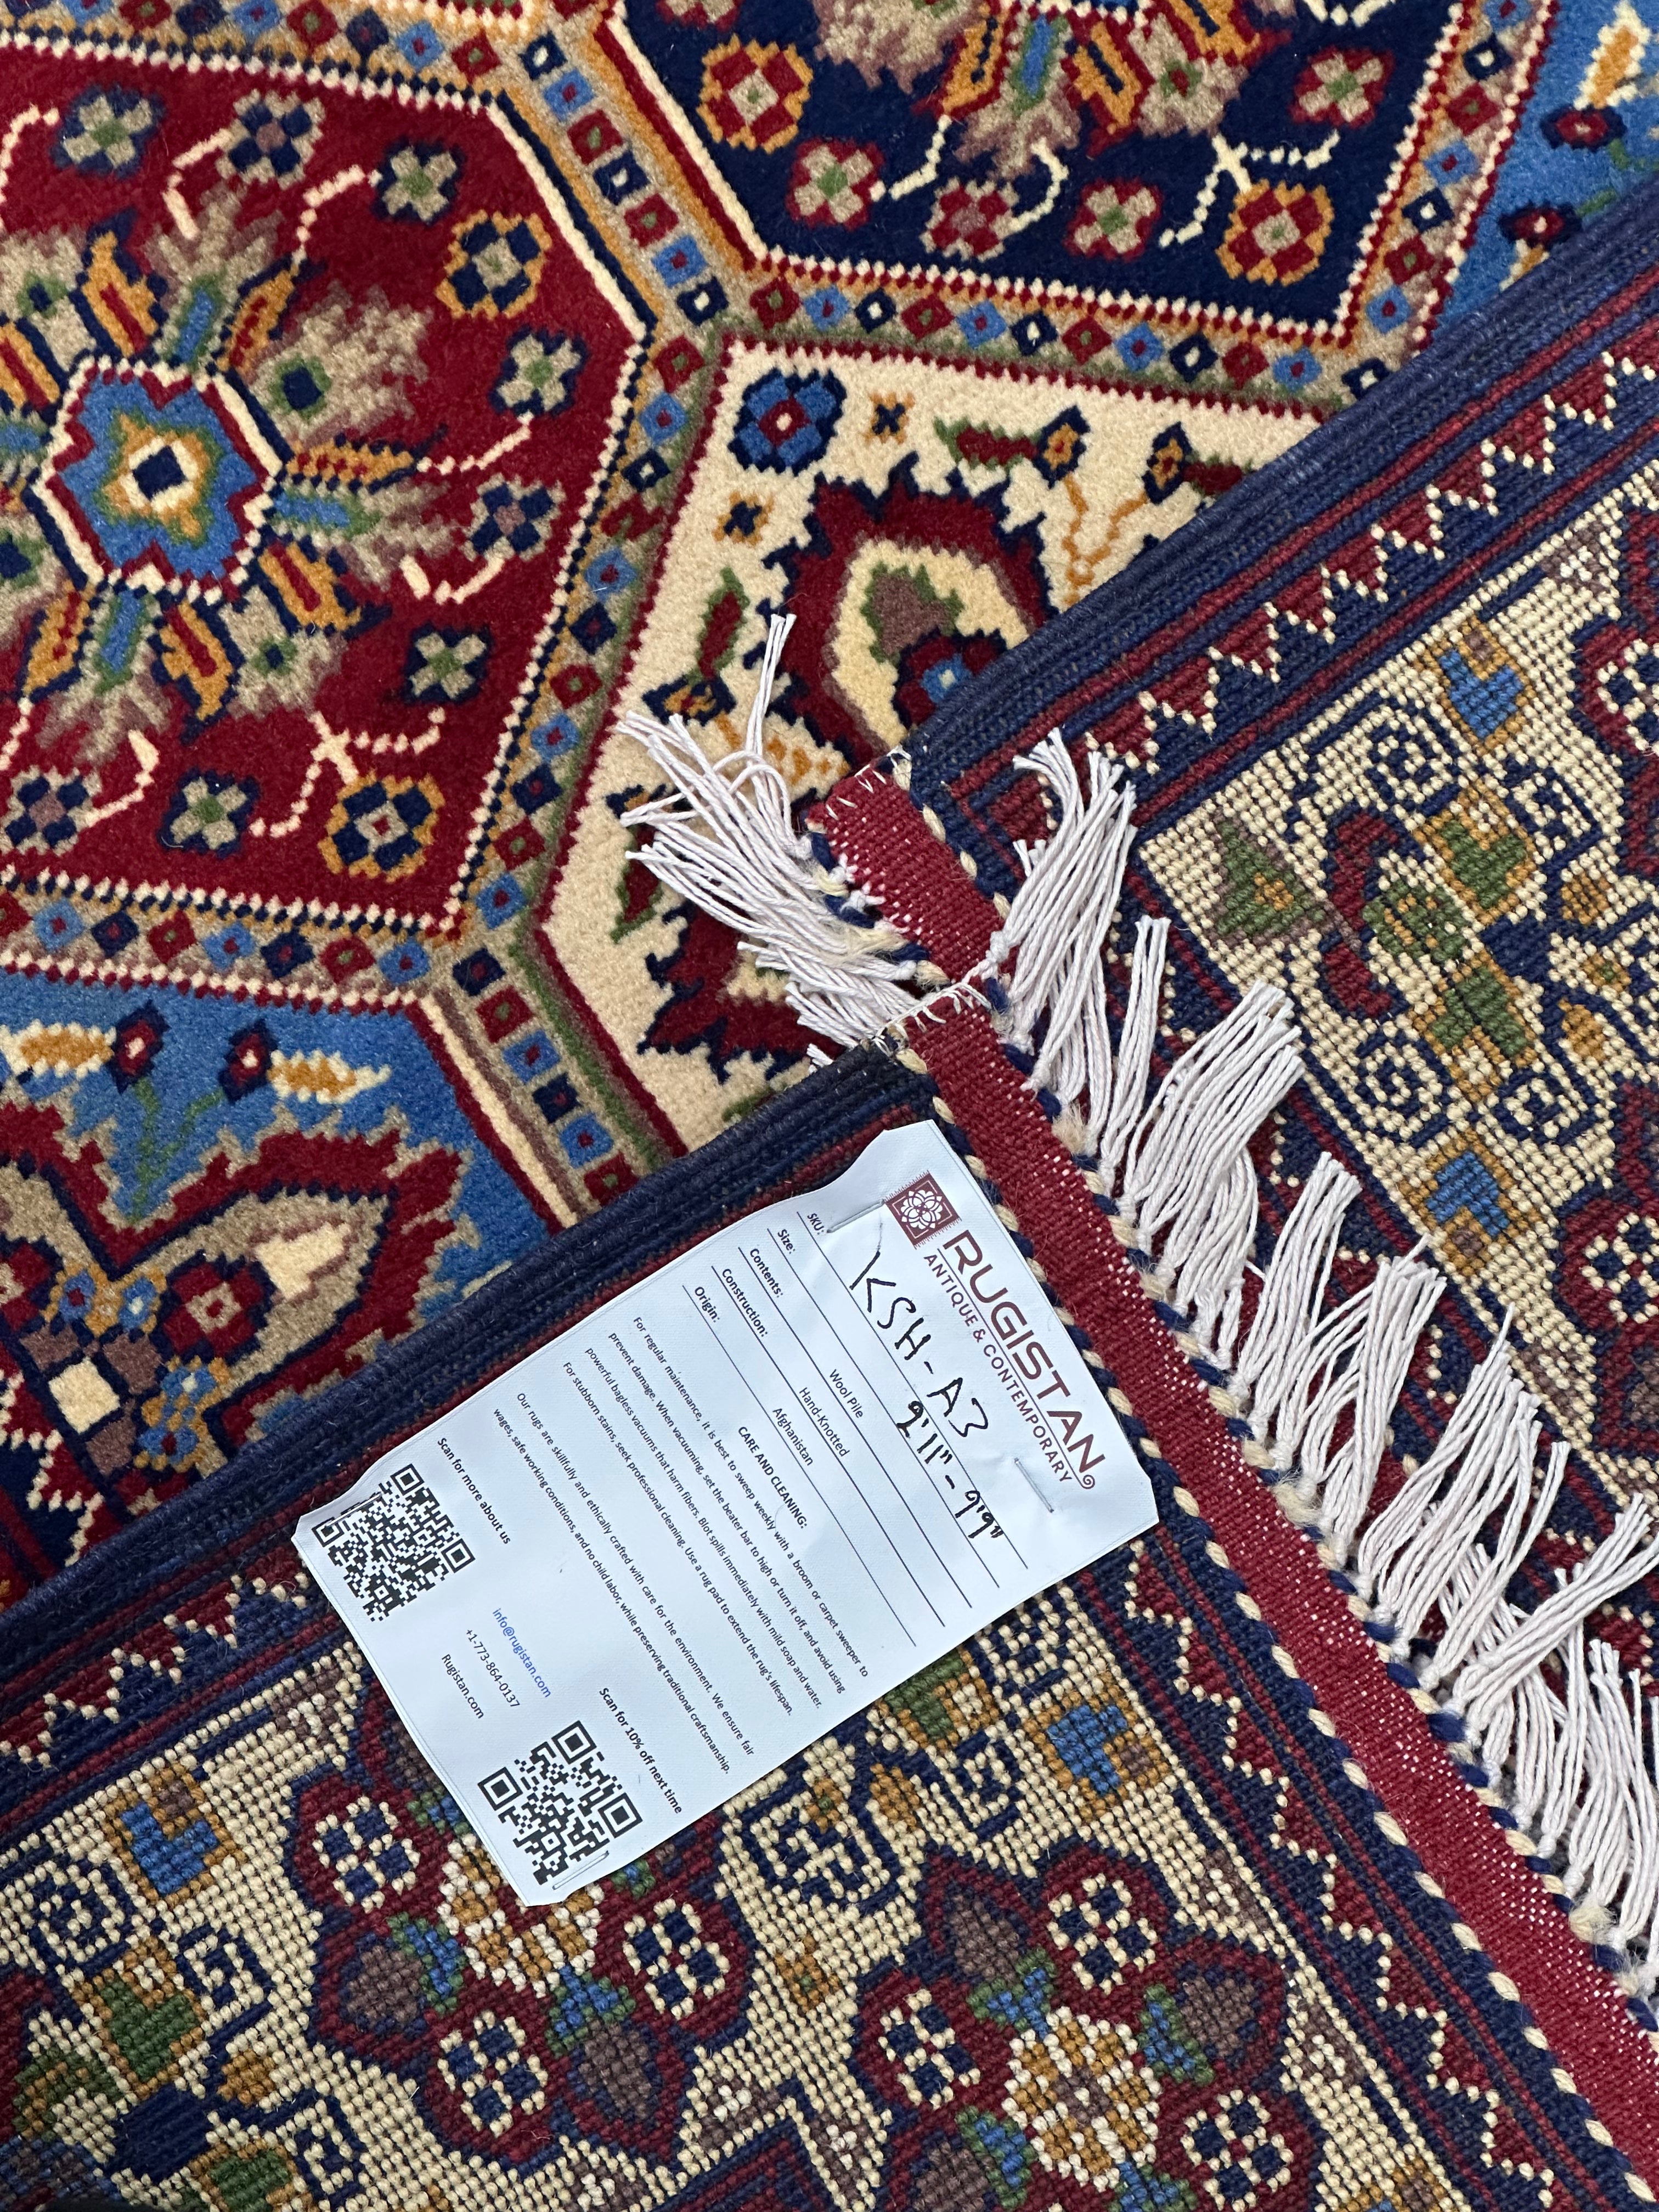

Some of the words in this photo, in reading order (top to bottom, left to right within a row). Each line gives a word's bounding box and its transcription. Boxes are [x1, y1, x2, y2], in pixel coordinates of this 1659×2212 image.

[776, 1228, 795, 1255] Size:
[806, 1212, 825, 1235] SKU:
[693, 1286, 720, 1323] Origin:
[721, 1268, 768, 1338] Construction:
[749, 1248, 783, 1299] Contents:
[828, 1368, 853, 1399] Wool
[846, 1396, 863, 1419] Pile
[922, 1254, 979, 1327] ANTIQUE
[972, 1328, 986, 1344] &
[983, 1344, 1077, 1482] CONTEMPORARY
[941, 1229, 1106, 1474] RUGISTAN
[771, 1408, 813, 1466] Afghanistan
[798, 1386, 850, 1457] Hand-Knotted
[437, 1437, 455, 1460] Scan
[451, 1458, 465, 1474] for
[461, 1474, 482, 1502] more
[479, 1501, 503, 1532] about
[499, 1531, 511, 1544] us
[607, 1332, 635, 1366] prevent
[631, 1365, 656, 1402] damage.
[655, 1400, 674, 1427] When
[672, 1426, 704, 1475] vacuuming,
[702, 1474, 715, 1489] set
[712, 1487, 725, 1504] the
[721, 1502, 743, 1531] beater
[739, 1530, 753, 1546] bar
[749, 1546, 759, 1558] to
[756, 1555, 772, 1577] high
[769, 1577, 780, 1587] or
[776, 1587, 792, 1608] turn
[788, 1606, 797, 1616] it
[793, 1615, 808, 1631] off,
[803, 1630, 819, 1647] and
[813, 1646, 833, 1671] avoid
[827, 1669, 845, 1695] using
[633, 1316, 646, 1332] For
[643, 1333, 667, 1364] regular
[664, 1365, 702, 1422] maintenance,
[701, 1420, 710, 1431] it
[707, 1430, 716, 1440] is
[713, 1439, 730, 1461] best
[726, 1460, 737, 1471] to
[734, 1472, 755, 1500] sweep
[753, 1500, 776, 1531] weekly
[773, 1531, 789, 1551] with
[786, 1551, 794, 1560] a
[792, 1560, 813, 1590] broom
[811, 1590, 821, 1600] or
[818, 1602, 839, 1630] carpet
[835, 1629, 861, 1664] sweeper
[859, 1665, 868, 1677] to
[737, 1426, 760, 1454] CARE
[753, 1453, 774, 1476] AND
[770, 1475, 807, 1530] CLEANING:
[516, 1392, 531, 1409] Our
[527, 1410, 544, 1430] rugs
[540, 1430, 554, 1446] are
[551, 1446, 577, 1480] skillfully
[574, 1481, 591, 1499] and
[586, 1499, 612, 1534] ethically
[609, 1535, 634, 1565] crafted
[628, 1565, 645, 1585] with
[641, 1585, 657, 1605] care
[653, 1604, 667, 1618] for
[663, 1620, 676, 1637] the
[674, 1637, 713, 1694] environment.
[711, 1692, 724, 1710] We
[721, 1711, 743, 1740] ensure
[740, 1740, 754, 1756] fair
[562, 1361, 576, 1377] For
[572, 1377, 600, 1415] stubborn
[596, 1415, 617, 1443] stains,
[614, 1441, 632, 1463] seek
[625, 1462, 666, 1513] professional
[660, 1511, 686, 1549] cleaning.
[684, 1547, 697, 1565] Use
[698, 1571, 712, 1588] rug
[707, 1586, 725, 1605] pad
[720, 1603, 730, 1615] to
[727, 1615, 751, 1645] extend
[746, 1643, 759, 1660] the
[755, 1659, 772, 1681] rug's
[769, 1679, 792, 1717] lifespan.
[584, 1347, 616, 1385] powerful
[610, 1383, 634, 1416] bagless
[630, 1414, 658, 1452] vacuums
[654, 1451, 670, 1471] that
[665, 1468, 684, 1493] harm
[680, 1491, 699, 1519] fibers.
[697, 1517, 713, 1537] Blot
[708, 1535, 726, 1557] spills
[722, 1555, 759, 1608] immediately
[755, 1607, 772, 1628] with
[768, 1627, 786, 1647] mild
[780, 1646, 796, 1667] soap
[792, 1666, 809, 1683] and
[803, 1681, 822, 1709] water.
[493, 1408, 514, 1437] wages,
[511, 1436, 526, 1454] safe
[523, 1453, 549, 1489] working
[545, 1487, 576, 1533] conditions,
[574, 1532, 590, 1550] and
[584, 1548, 595, 1560] no
[592, 1560, 611, 1581] child
[604, 1578, 622, 1604] labor,
[619, 1602, 637, 1627] while
[631, 1626, 666, 1672] preserving
[662, 1669, 696, 1714] traditional
[690, 1713, 730, 1774] craftsmanship.
[441, 1654, 484, 1719] Rugistan.com
[465, 1629, 521, 1707] +1-773-864-0137
[492, 1607, 551, 1698] info@rugistan.com
[598, 1687, 618, 1712] Scan
[614, 1711, 629, 1727] for
[624, 1726, 645, 1750] 10%
[639, 1750, 656, 1765] off
[648, 1765, 668, 1790] next
[663, 1788, 682, 1814] time
